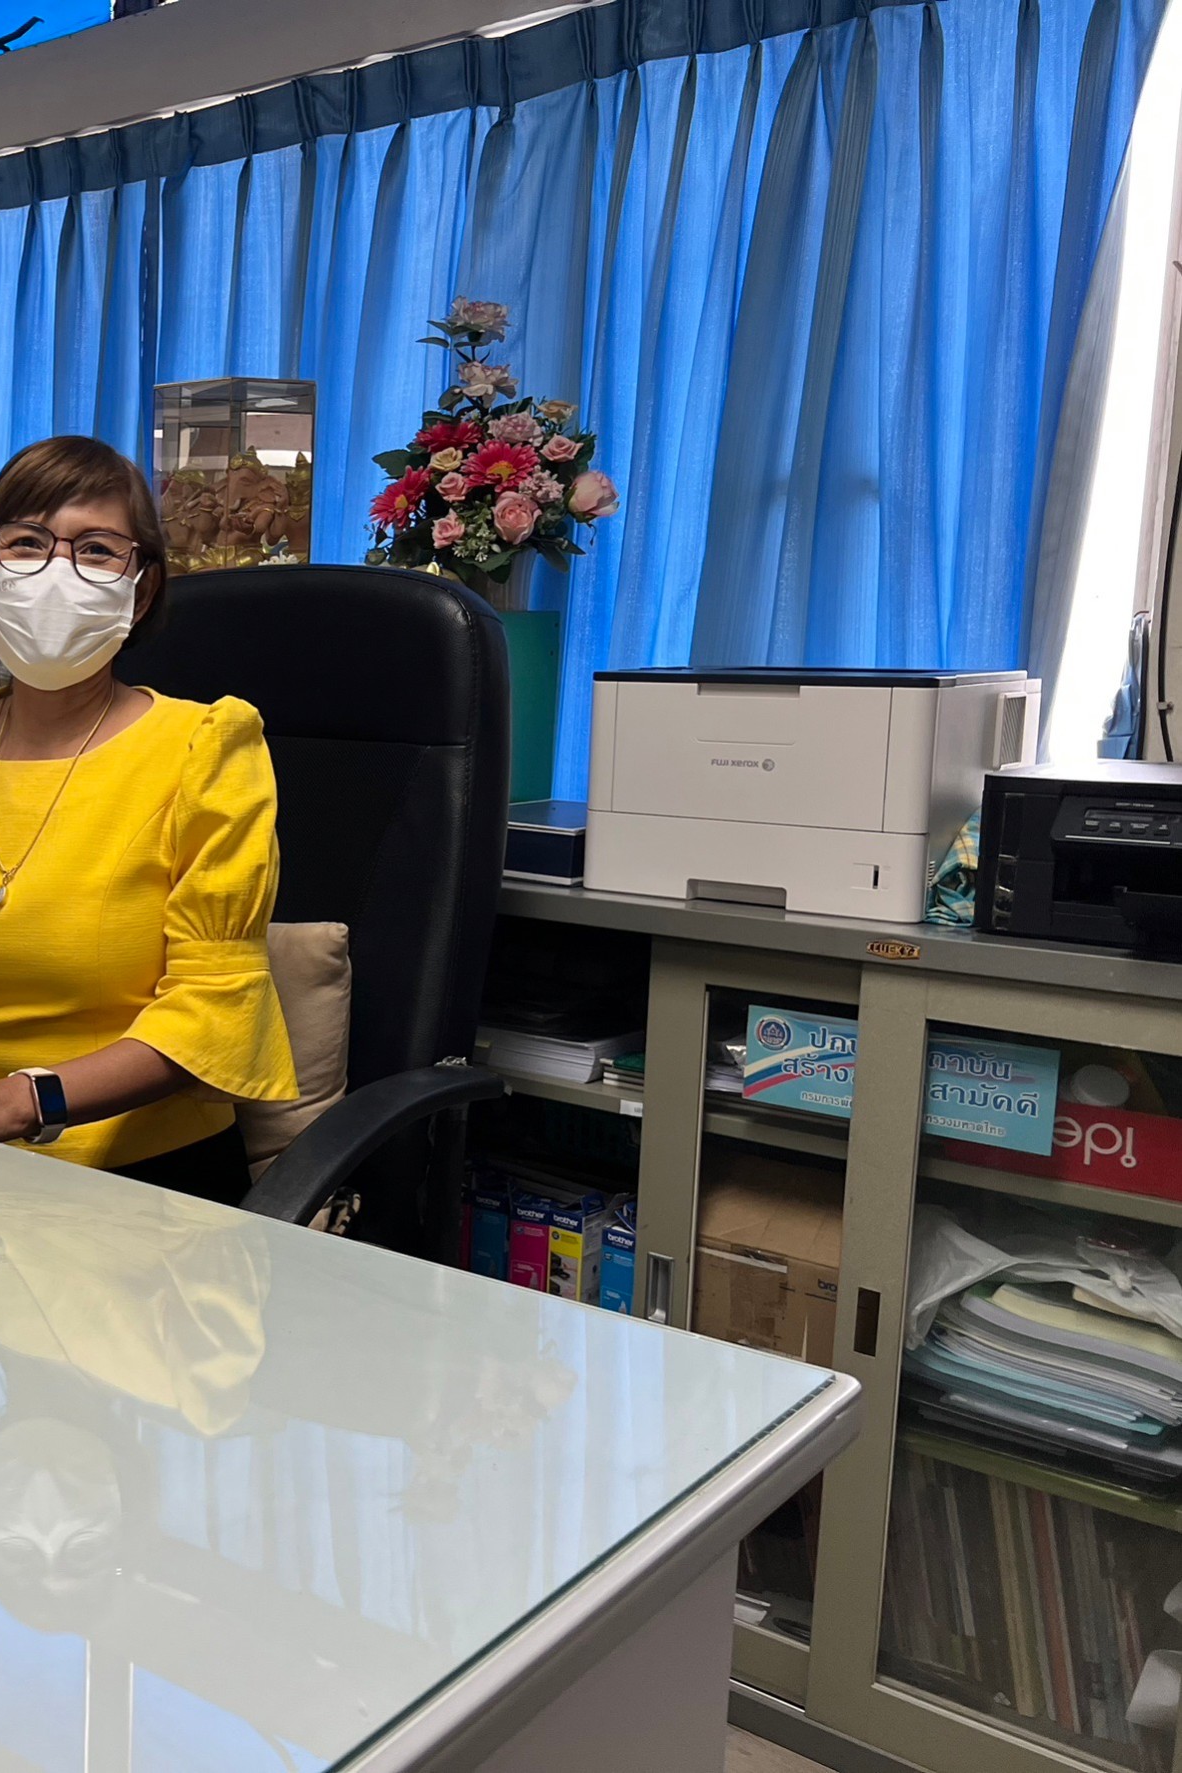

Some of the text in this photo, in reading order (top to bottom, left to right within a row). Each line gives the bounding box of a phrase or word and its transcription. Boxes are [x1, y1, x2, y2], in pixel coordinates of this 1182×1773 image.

[783, 1053, 1038, 1117] สร้าง สามัคคี
[517, 1208, 545, 1220] brother
[553, 1214, 579, 1227] brother
[607, 1233, 634, 1246] brother
